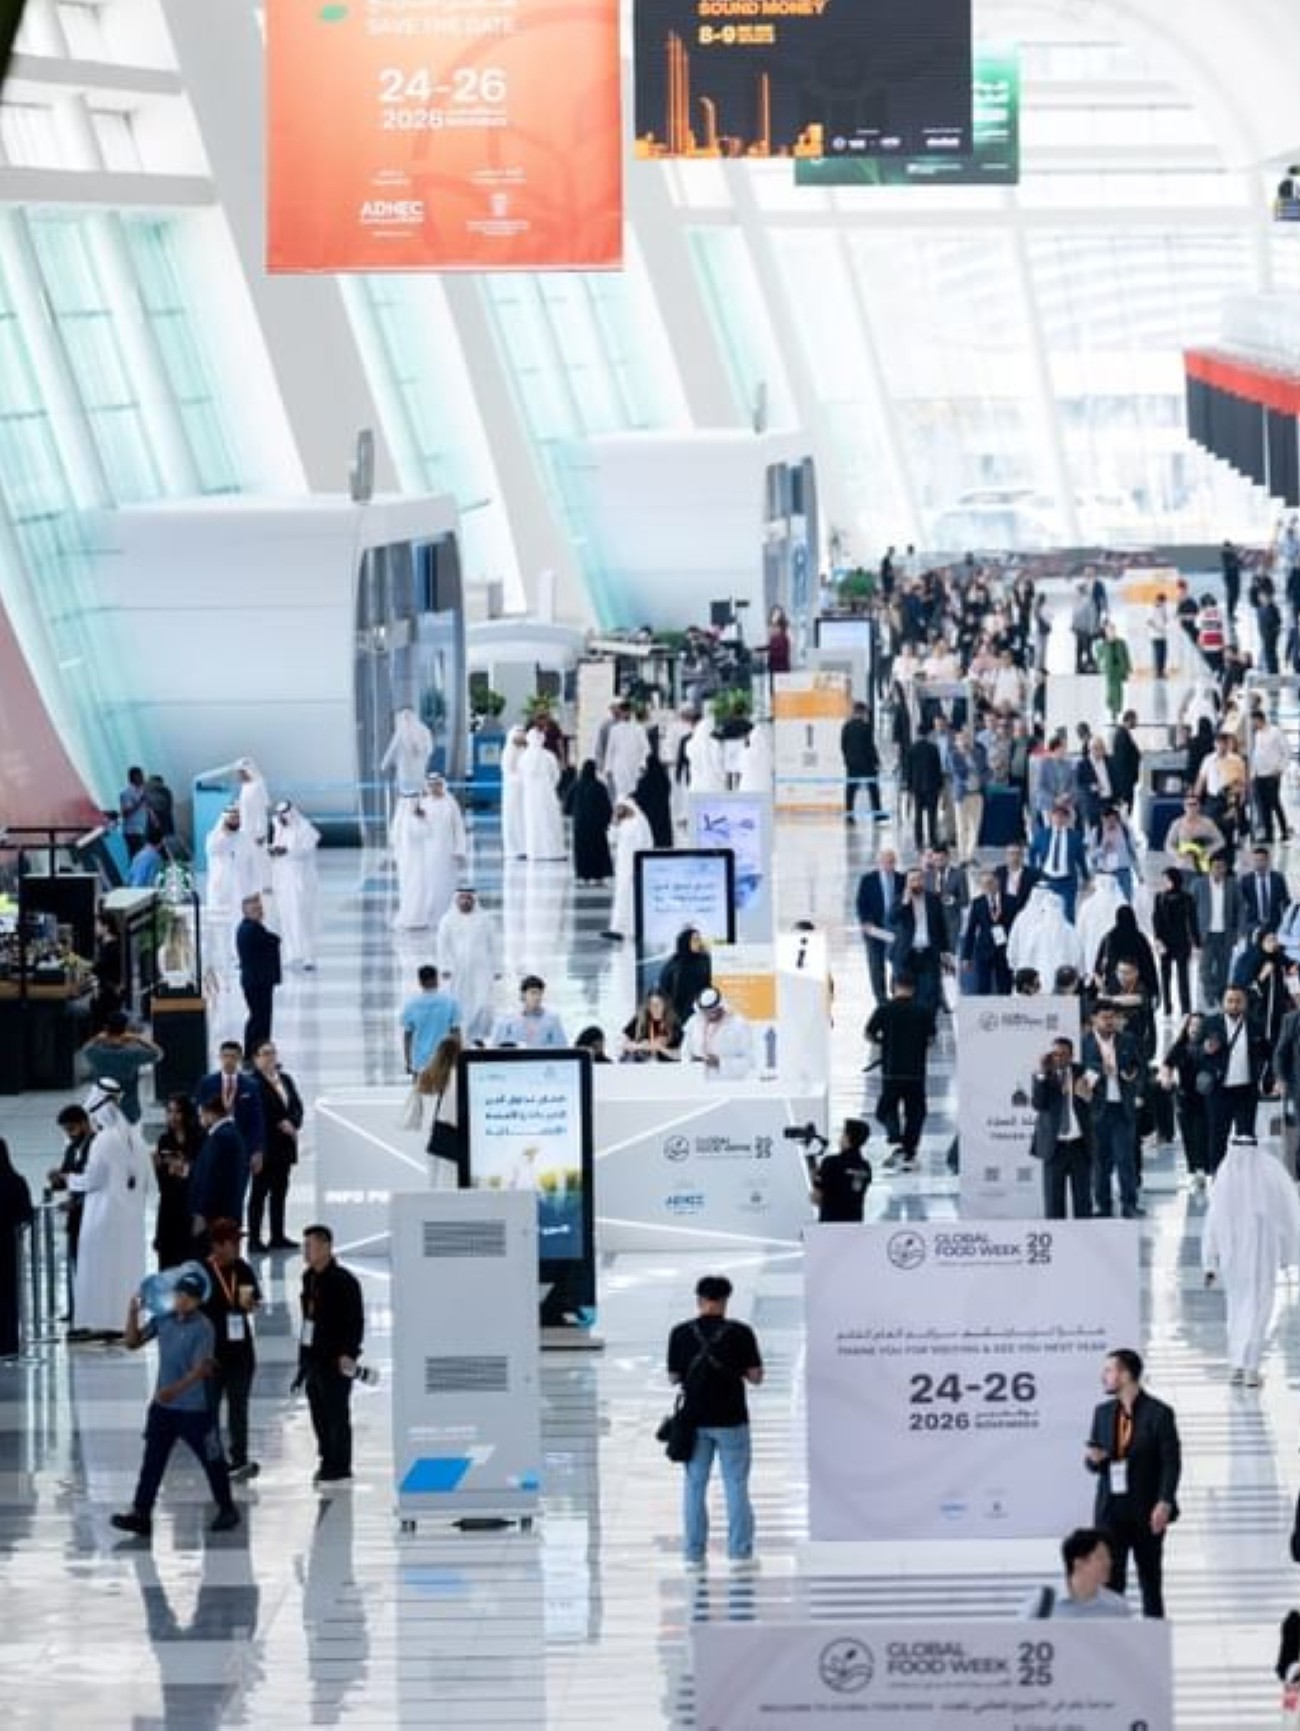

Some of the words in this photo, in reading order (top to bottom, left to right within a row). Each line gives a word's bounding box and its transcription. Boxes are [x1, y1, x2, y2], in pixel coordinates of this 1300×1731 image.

[379, 68, 507, 103] 24-26
[383, 109, 443, 129] 2026
[934, 1232, 990, 1244] GLOBAL
[1026, 1233, 1053, 1248] 20
[934, 1244, 977, 1258] FOOD
[979, 1243, 1021, 1257] WEEK
[1026, 1249, 1052, 1264] 25
[909, 1371, 1037, 1405] 24-26
[909, 1411, 970, 1431] 2026
[886, 1641, 965, 1659] GLOBAL
[1018, 1641, 1055, 1664] 20
[886, 1658, 946, 1676] FOOD
[949, 1657, 1009, 1675] WEEK
[1018, 1664, 1053, 1687] 25
